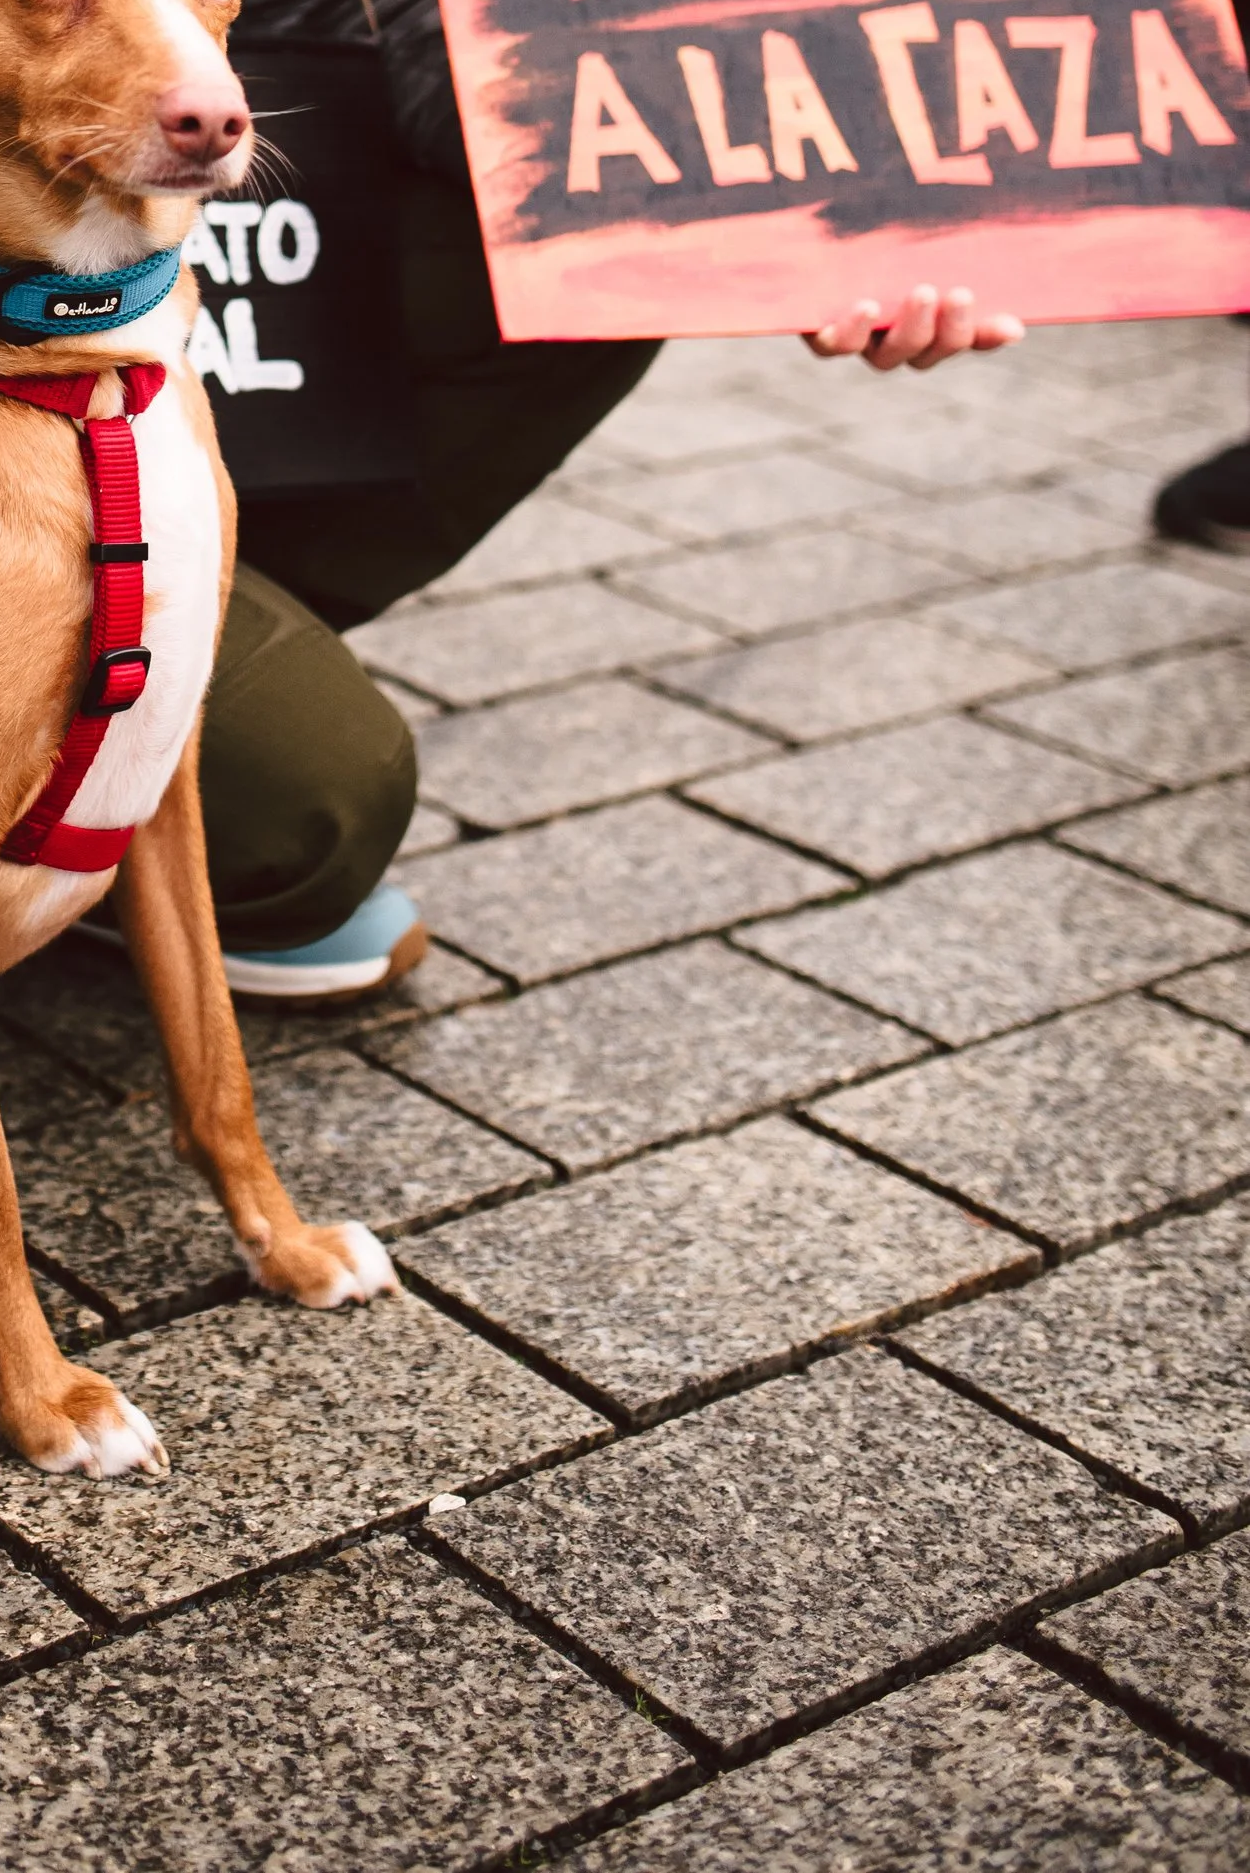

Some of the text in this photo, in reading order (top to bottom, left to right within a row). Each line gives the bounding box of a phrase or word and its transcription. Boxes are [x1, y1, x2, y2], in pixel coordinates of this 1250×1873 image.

[566, 1, 1236, 194] A LA CAZA
[181, 198, 321, 286] ATO
[53, 297, 118, 316] Petlando
[186, 297, 305, 395] AL
